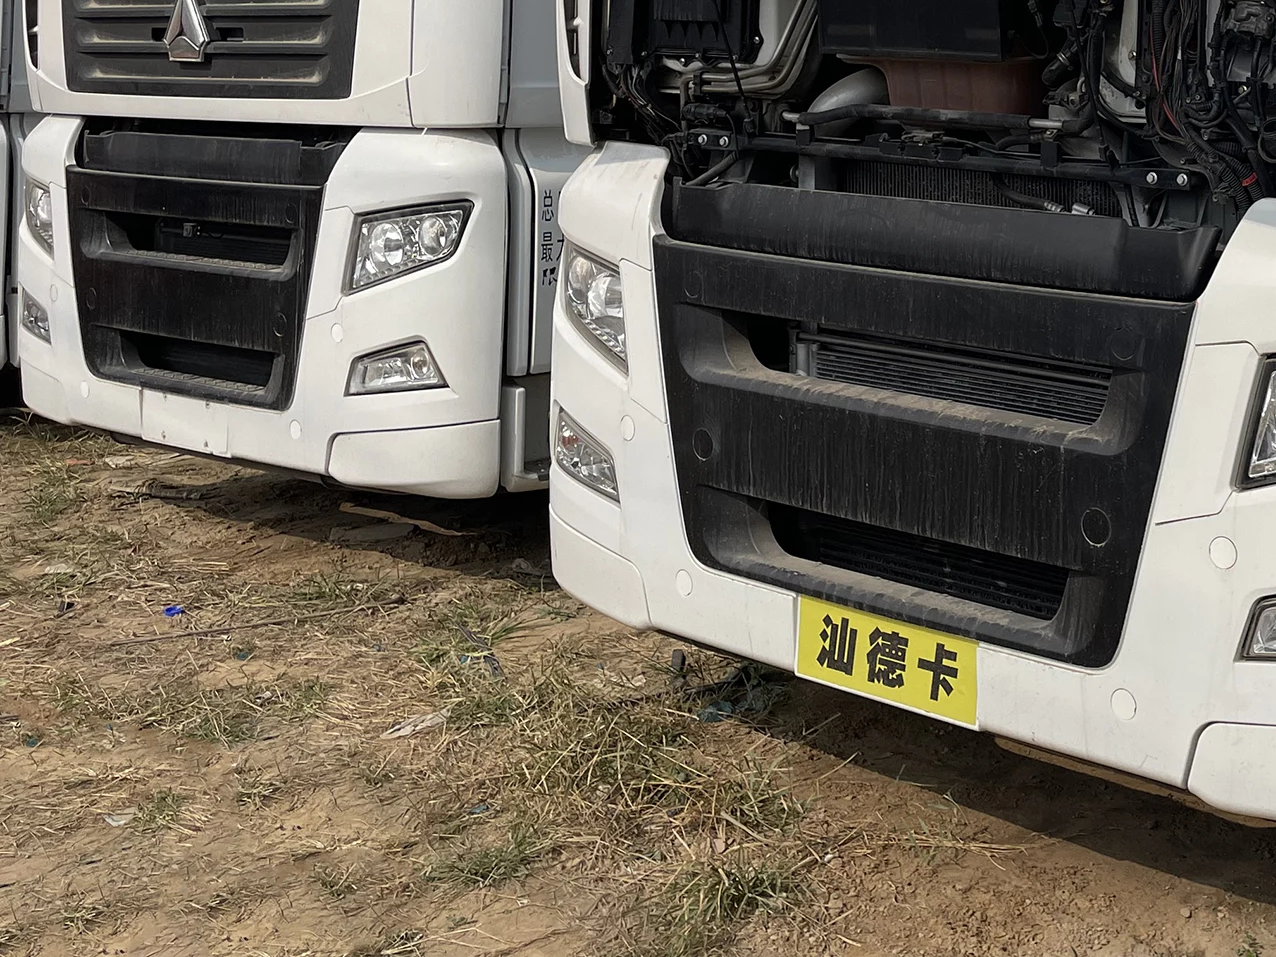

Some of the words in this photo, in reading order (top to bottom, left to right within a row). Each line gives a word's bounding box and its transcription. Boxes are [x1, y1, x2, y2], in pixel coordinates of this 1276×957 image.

[541, 189, 561, 222] 总
[816, 614, 958, 701] 汕德卡
